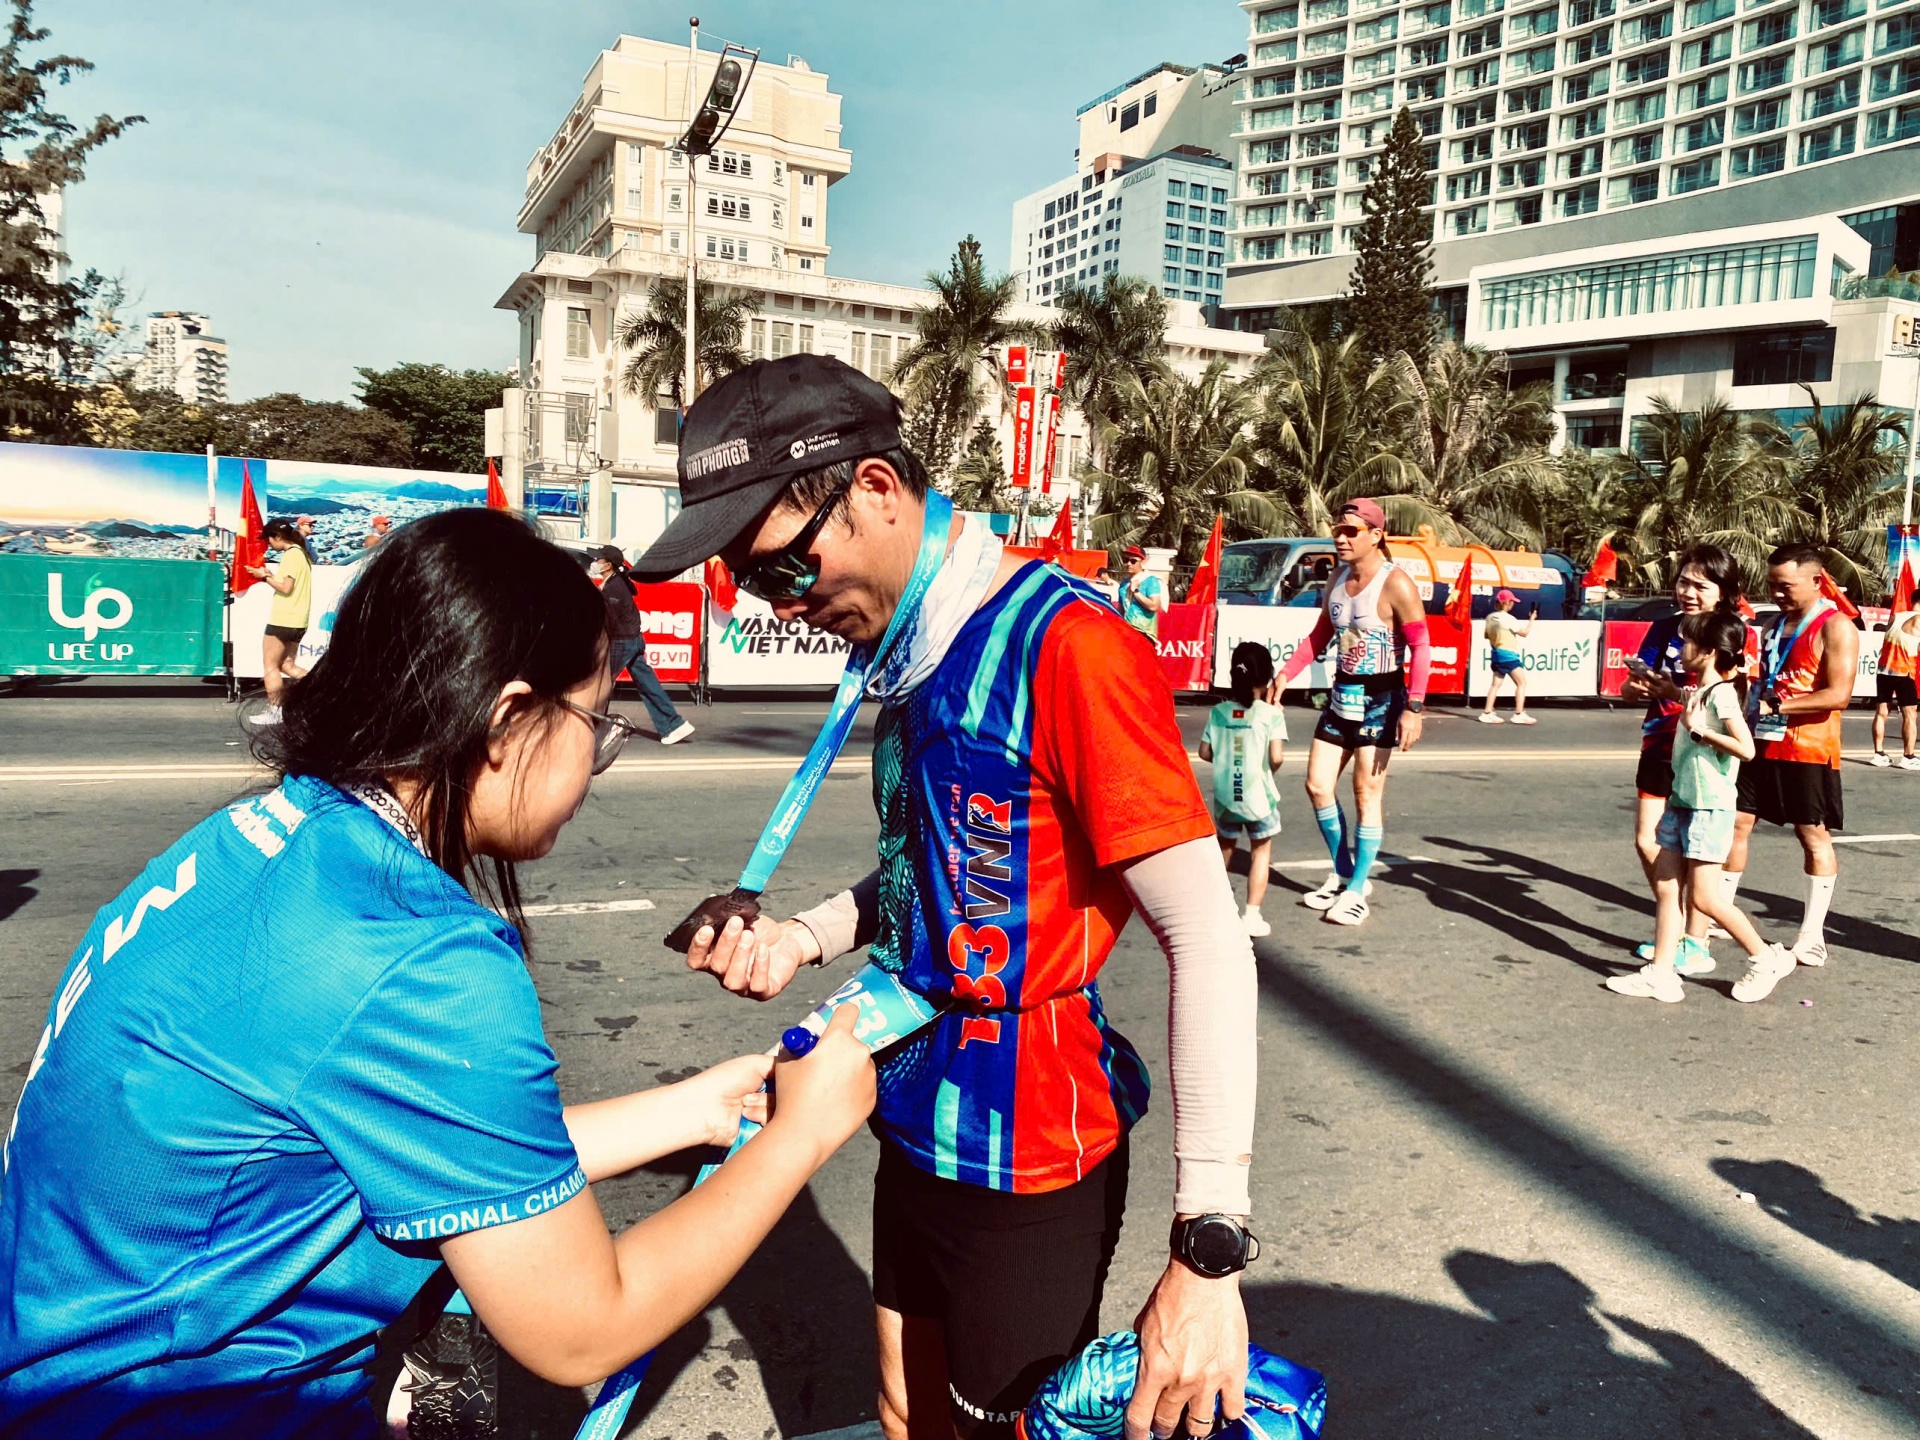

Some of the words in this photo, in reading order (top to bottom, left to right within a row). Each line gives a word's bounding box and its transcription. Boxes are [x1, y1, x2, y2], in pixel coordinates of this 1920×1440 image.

[807, 437, 841, 453] Marathon
[48, 642, 95, 661] LIFE
[100, 643, 134, 661] UP
[793, 636, 851, 654] NAM
[1154, 639, 1206, 658] BANK
[1482, 647, 1580, 672] Hbalife
[376, 1202, 518, 1241] NATIONAL
